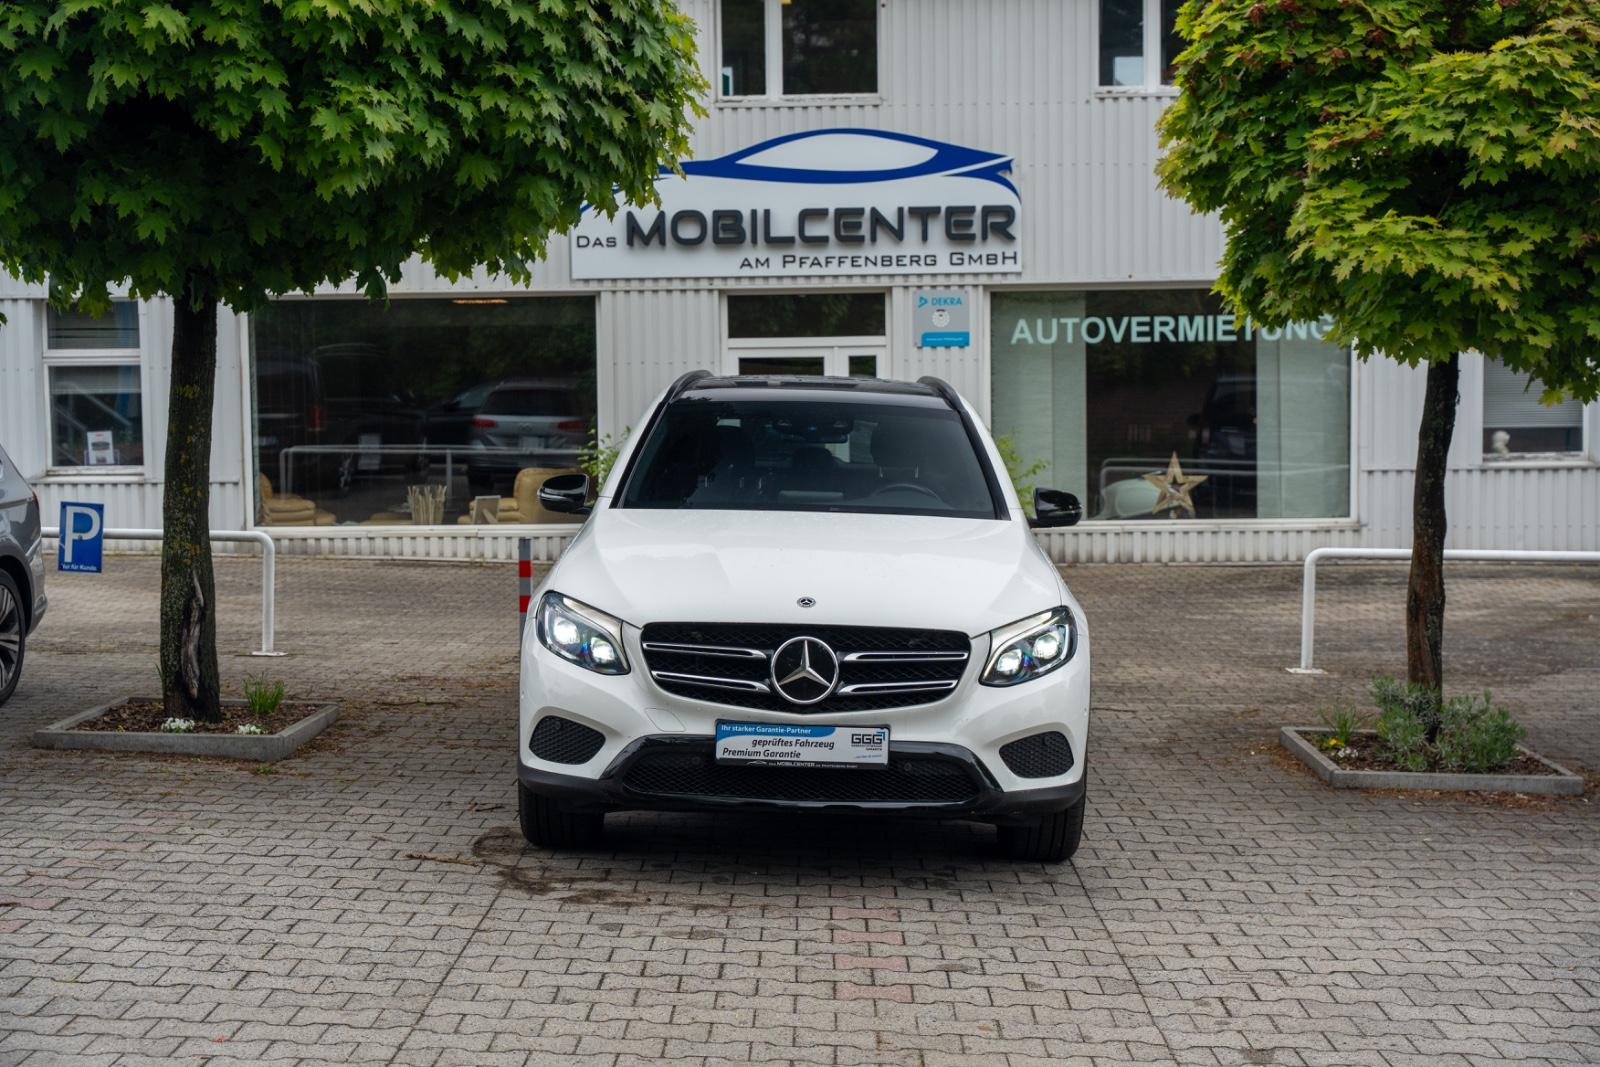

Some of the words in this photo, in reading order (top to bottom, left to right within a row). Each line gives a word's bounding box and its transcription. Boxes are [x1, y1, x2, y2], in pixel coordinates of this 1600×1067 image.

[626, 204, 1017, 247] MOBILCENTER
[931, 296, 963, 306] DEKRA
[64, 505, 101, 563] P
[751, 738, 793, 749] geprüftes
[794, 739, 835, 750] Fahrzeug
[851, 733, 882, 744] GGG
[722, 747, 762, 758] Premium
[763, 749, 801, 759] Garantie
